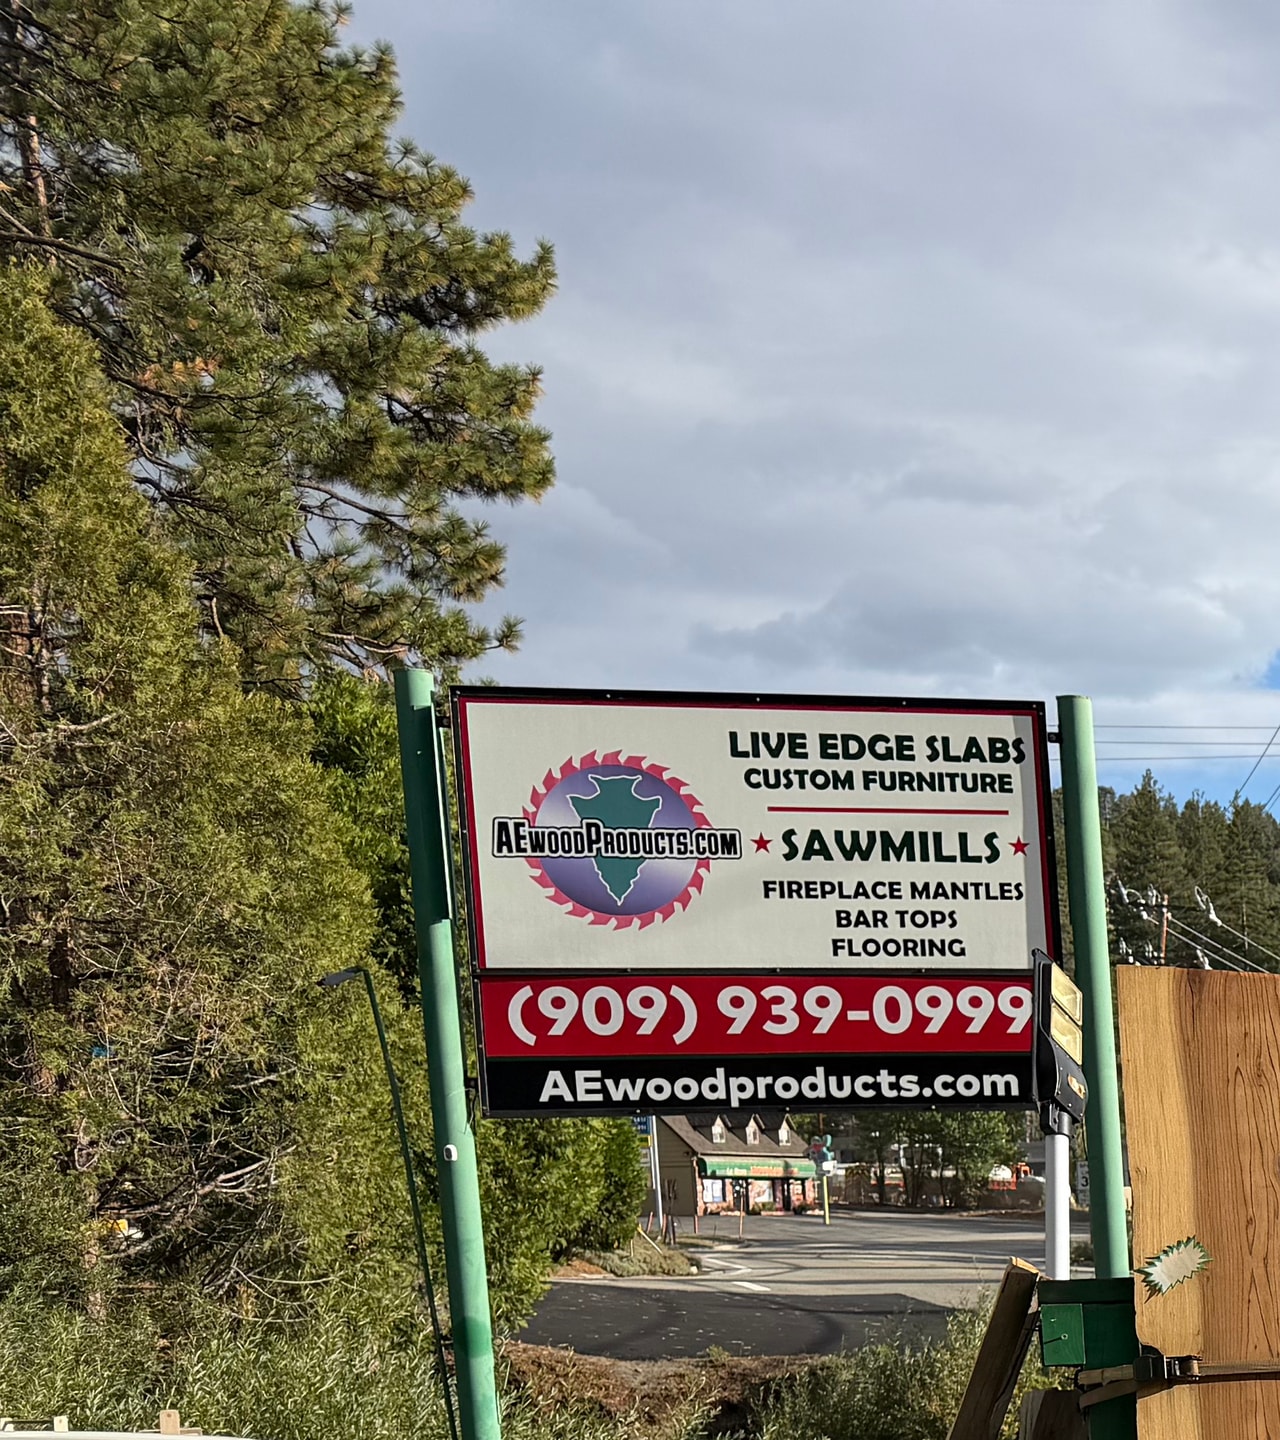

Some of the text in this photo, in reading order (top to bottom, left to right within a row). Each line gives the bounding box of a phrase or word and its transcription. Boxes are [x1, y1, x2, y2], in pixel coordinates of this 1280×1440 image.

[729, 731, 1026, 765] LIVE EDGE SLABS
[744, 768, 1014, 794] CUSTOM FURNITURE
[781, 828, 1001, 864] SAWMILLS
[762, 880, 1024, 901] FIREPLACE MANTLES
[835, 909, 958, 929] BAR TOPS
[831, 938, 967, 957] FLOORING
[507, 984, 1033, 1047] (909) 939-0999
[538, 1066, 1020, 1108] AEwoodproducts.com
